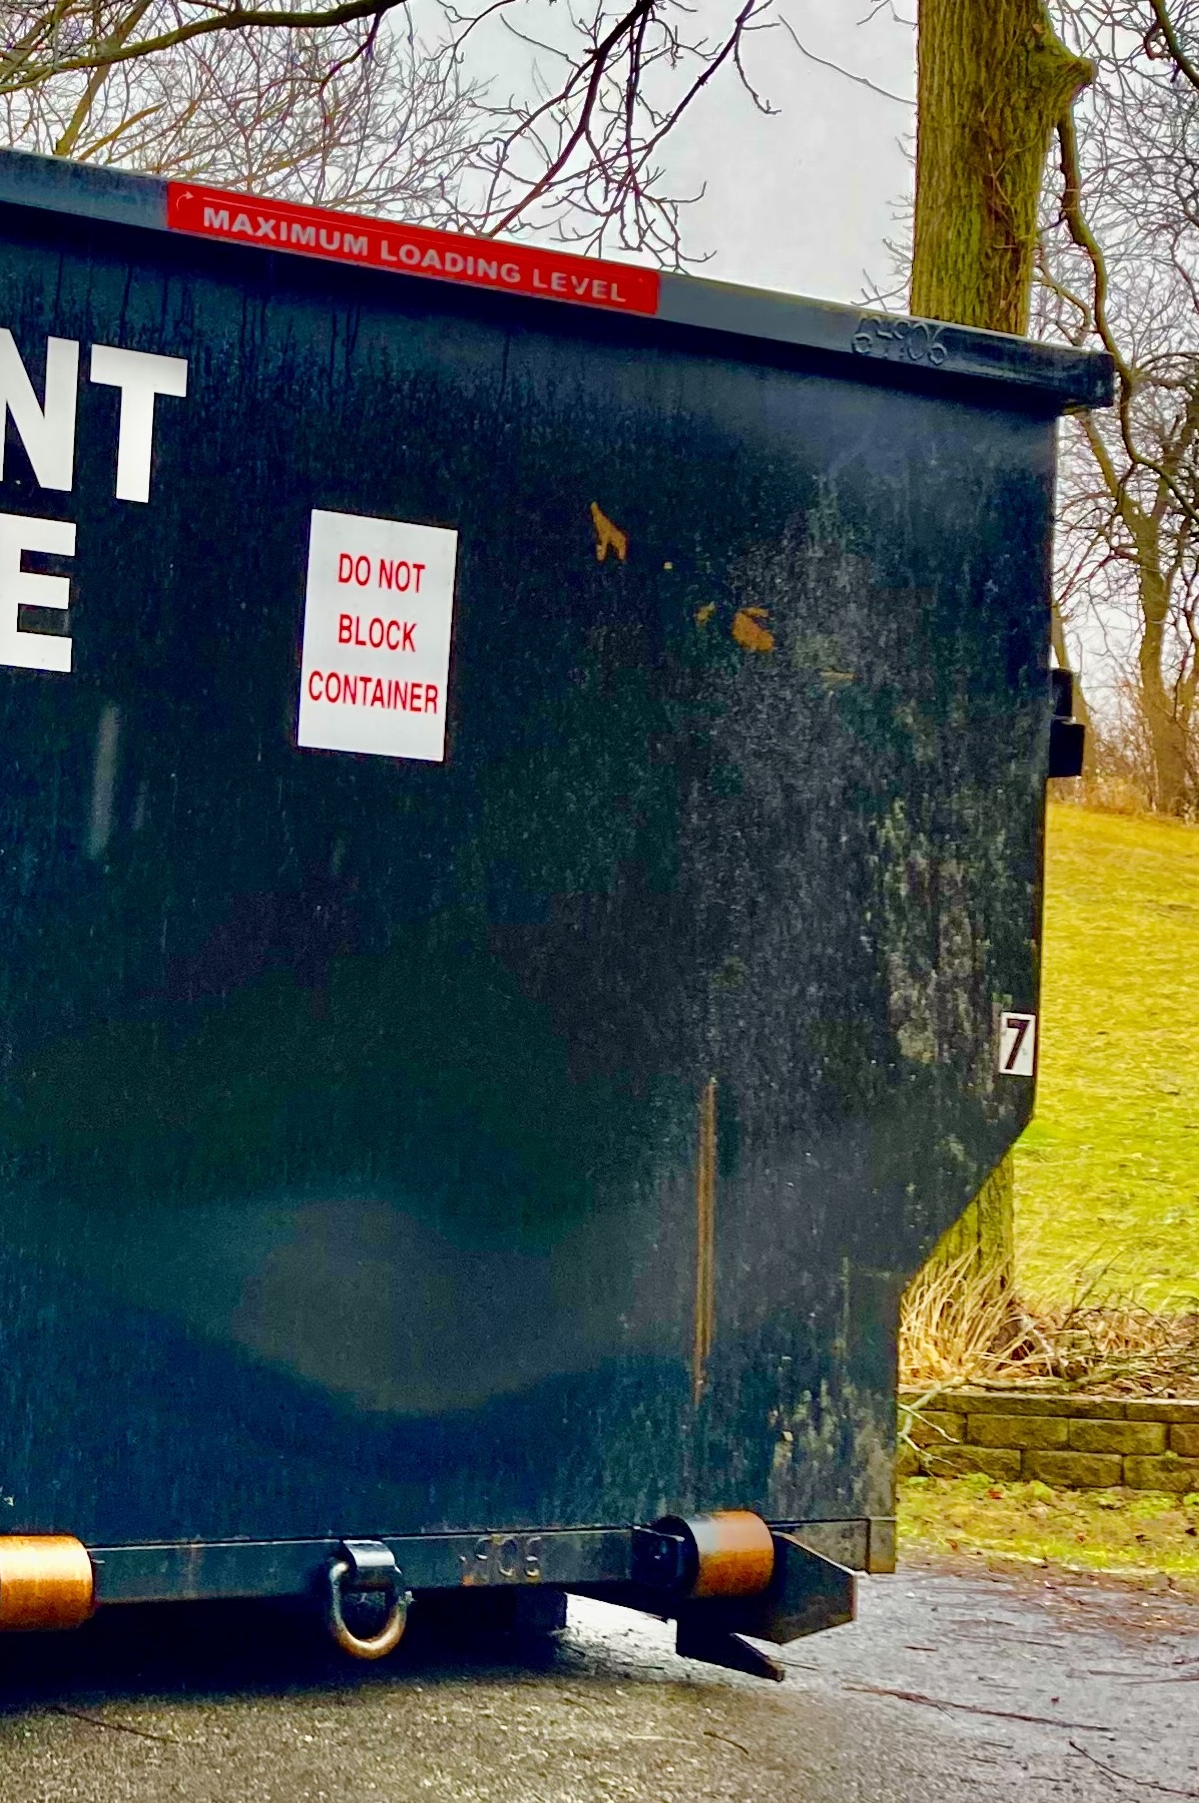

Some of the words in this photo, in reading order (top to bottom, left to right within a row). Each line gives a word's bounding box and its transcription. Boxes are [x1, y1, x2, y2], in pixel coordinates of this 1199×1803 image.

[203, 206, 368, 256] MAXIMUM
[379, 239, 521, 284] LOADING
[532, 268, 627, 303] LEVEL
[338, 553, 371, 586] DO
[378, 558, 426, 593] NOT
[338, 614, 417, 652] BLOCK
[308, 670, 439, 714] CONTAINER
[1004, 1018, 1031, 1070] 7
